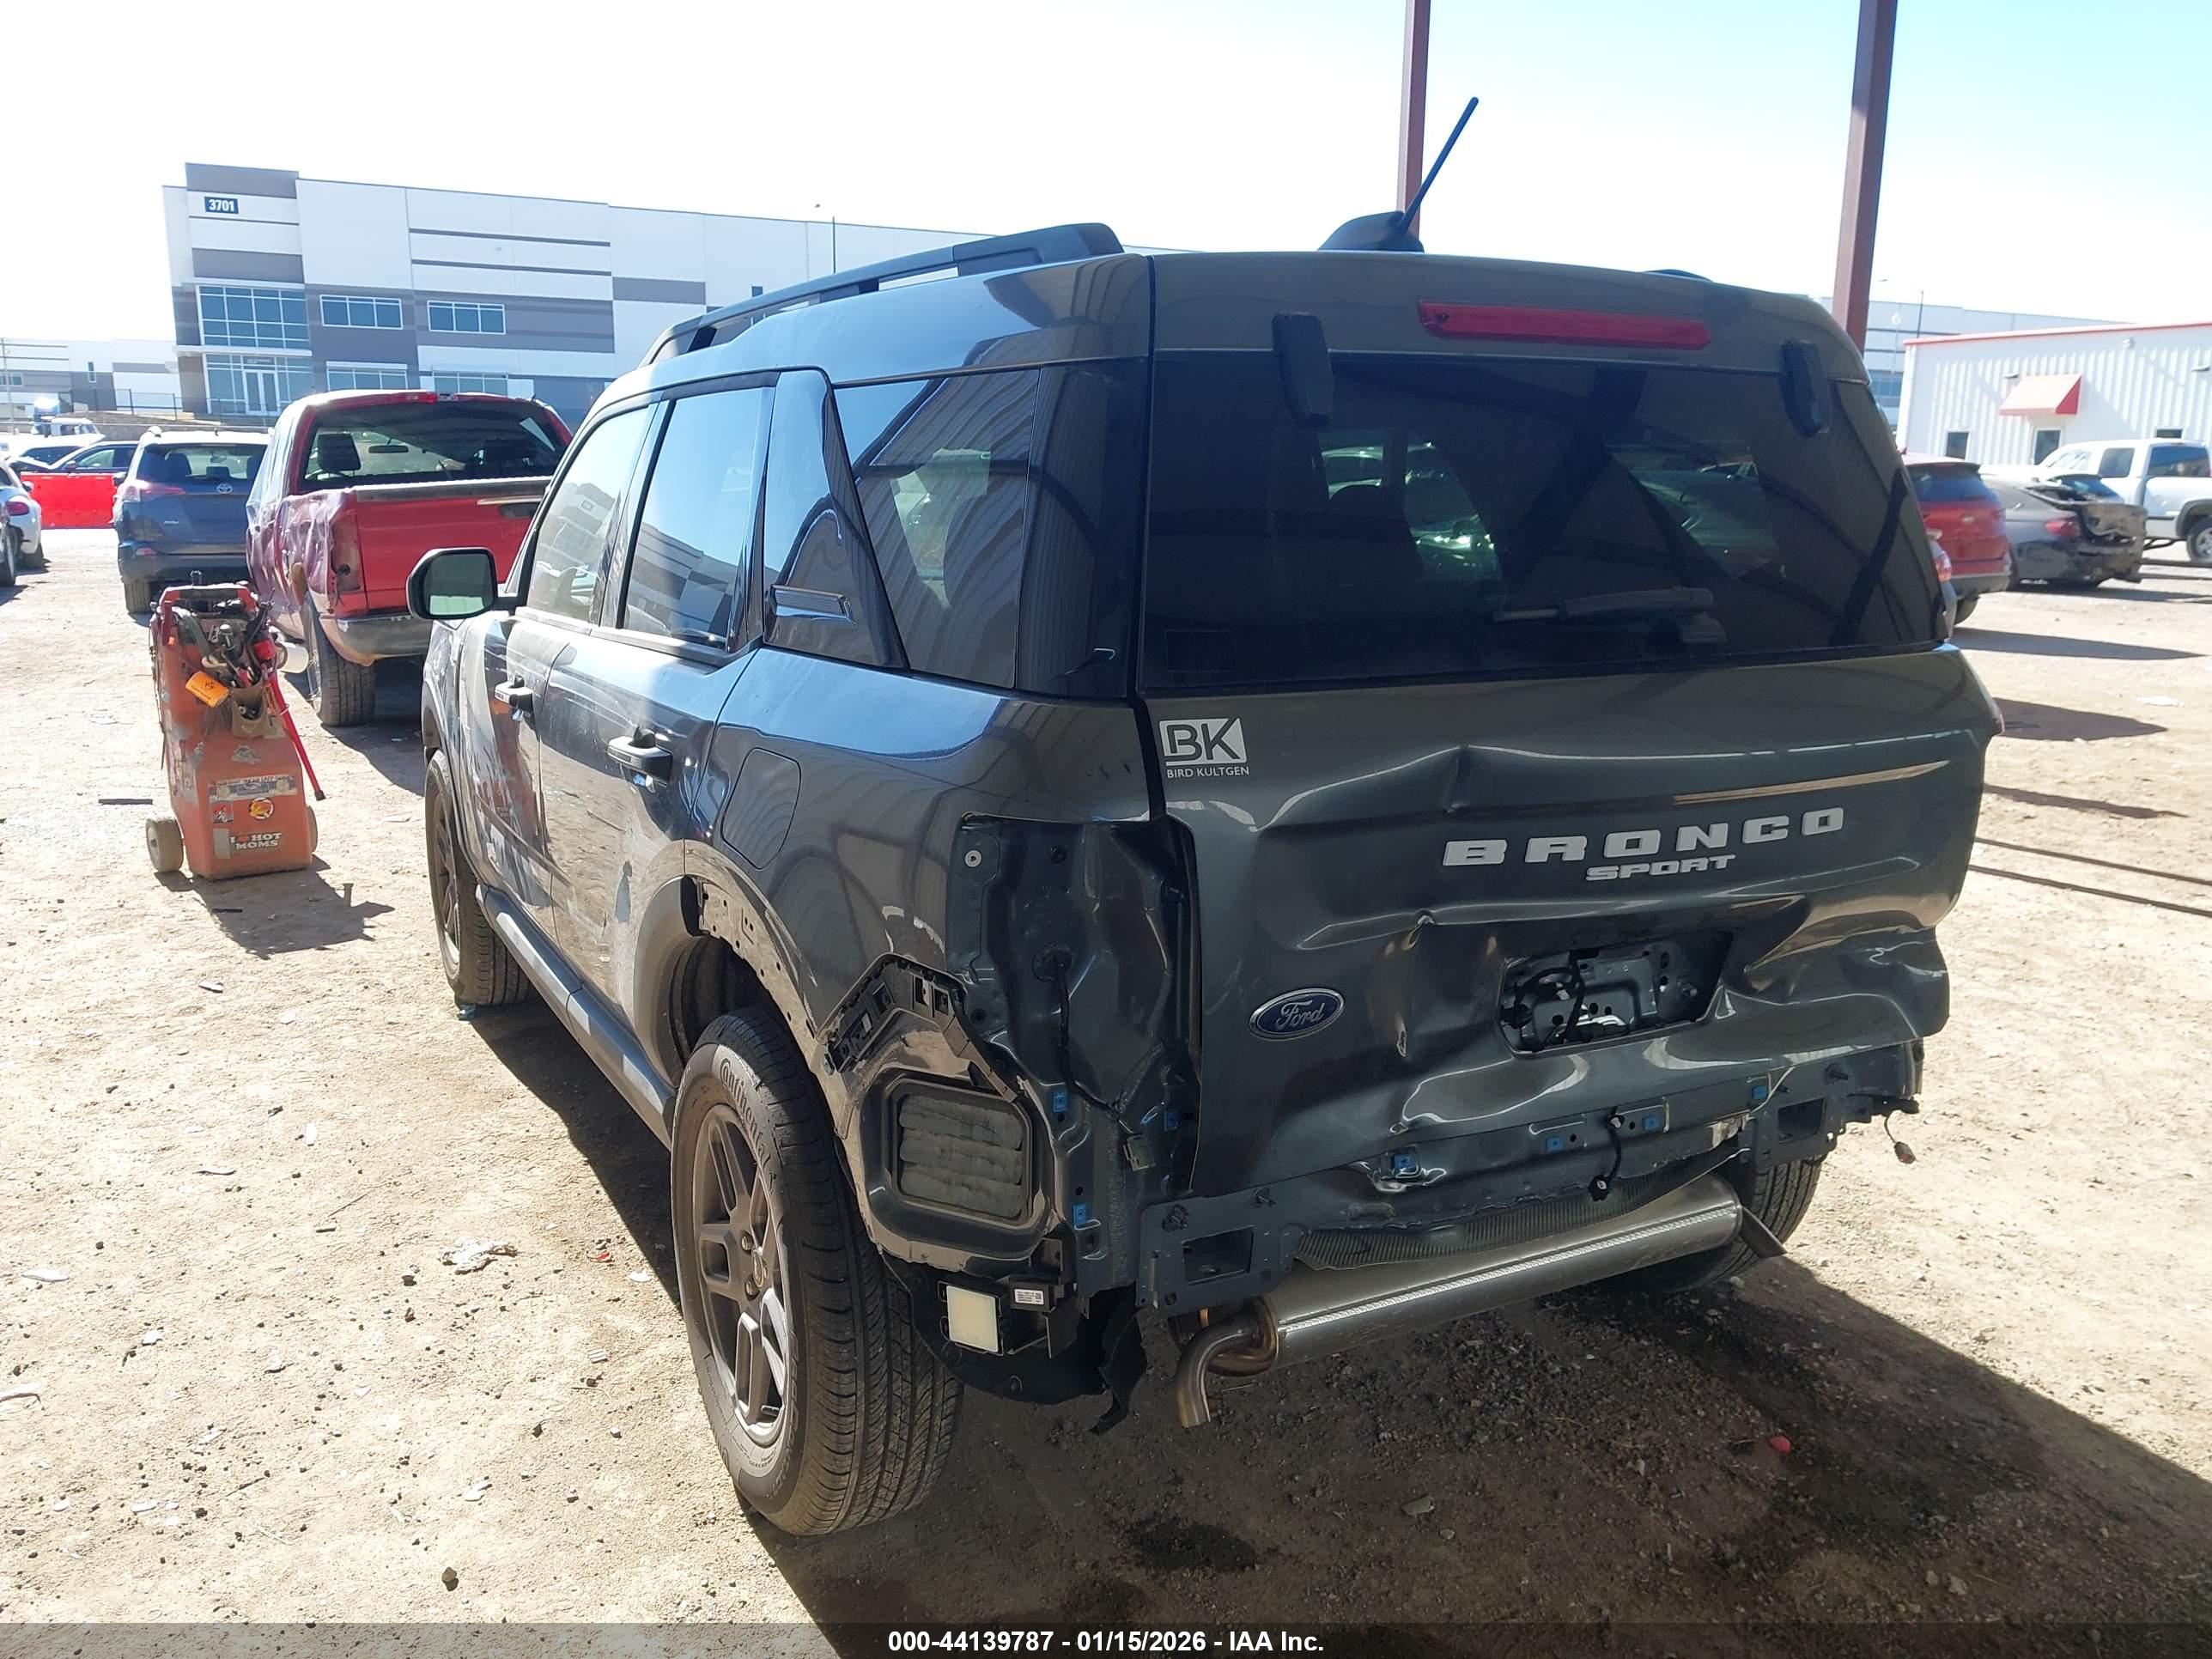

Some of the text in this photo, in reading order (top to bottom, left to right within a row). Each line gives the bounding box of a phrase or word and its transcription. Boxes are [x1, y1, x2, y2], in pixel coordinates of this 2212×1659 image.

[209, 198, 234, 212] 3701
[1164, 718, 1242, 763] BK
[1167, 766, 1249, 779] BIRD KULTGEN
[235, 840, 279, 851] MOMS
[251, 832, 282, 842] HOT
[1443, 807, 1844, 866] BRONCO
[1585, 854, 1736, 881] SPORT
[1274, 1000, 1325, 1030] Ford
[719, 1057, 772, 1170] Continental
